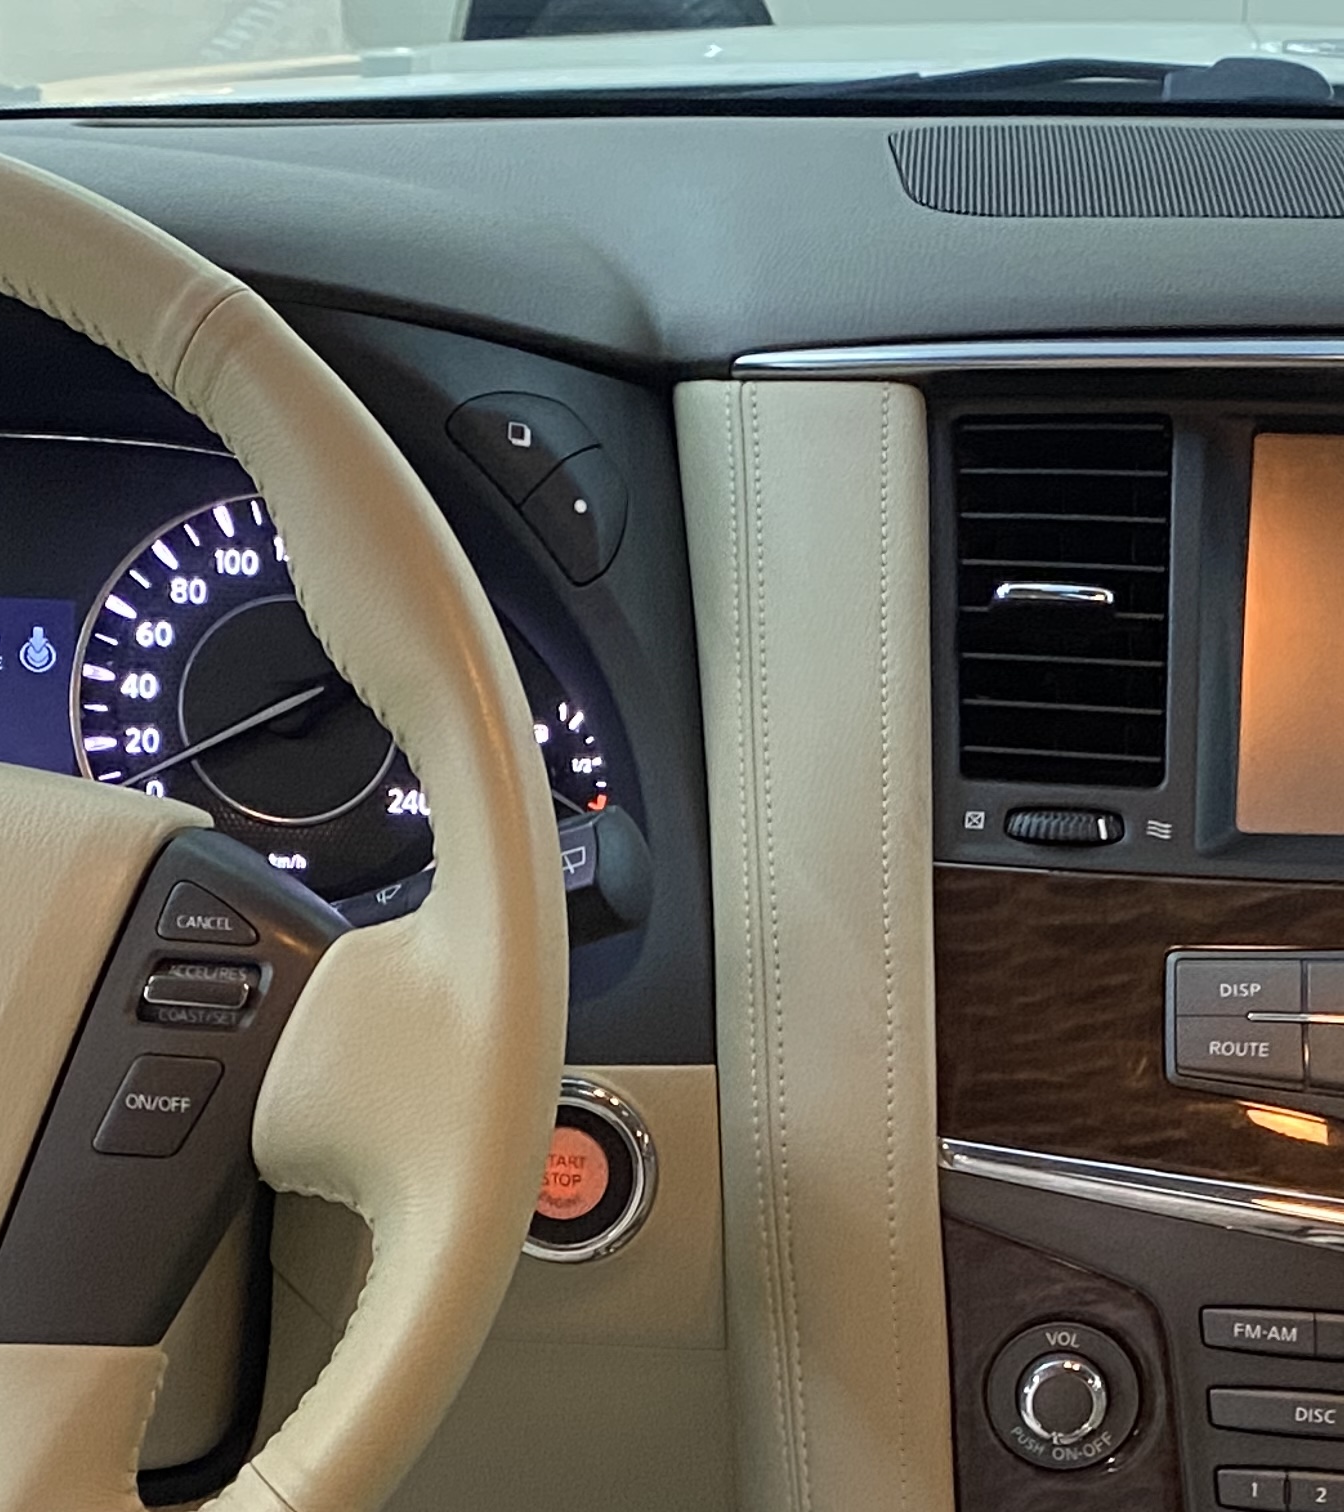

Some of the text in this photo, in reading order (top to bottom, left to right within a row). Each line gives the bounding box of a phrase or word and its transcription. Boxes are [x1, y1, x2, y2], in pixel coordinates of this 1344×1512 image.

[214, 549, 259, 575] 100
[170, 576, 207, 604] 80
[135, 621, 173, 647] 60
[120, 673, 158, 699] 40
[125, 727, 160, 753] 20
[176, 915, 233, 931] CANCEL
[1219, 982, 1261, 998] DISP
[1209, 1040, 1270, 1057] ROUTE
[125, 1094, 191, 1114] ON/OFF
[549, 1154, 586, 1169] TART
[1045, 1331, 1080, 1349] VOL
[1295, 1407, 1336, 1424] DISC
[1011, 1426, 1045, 1456] PUSH
[1251, 1482, 1258, 1498] 1
[1315, 1487, 1327, 1503] 2
